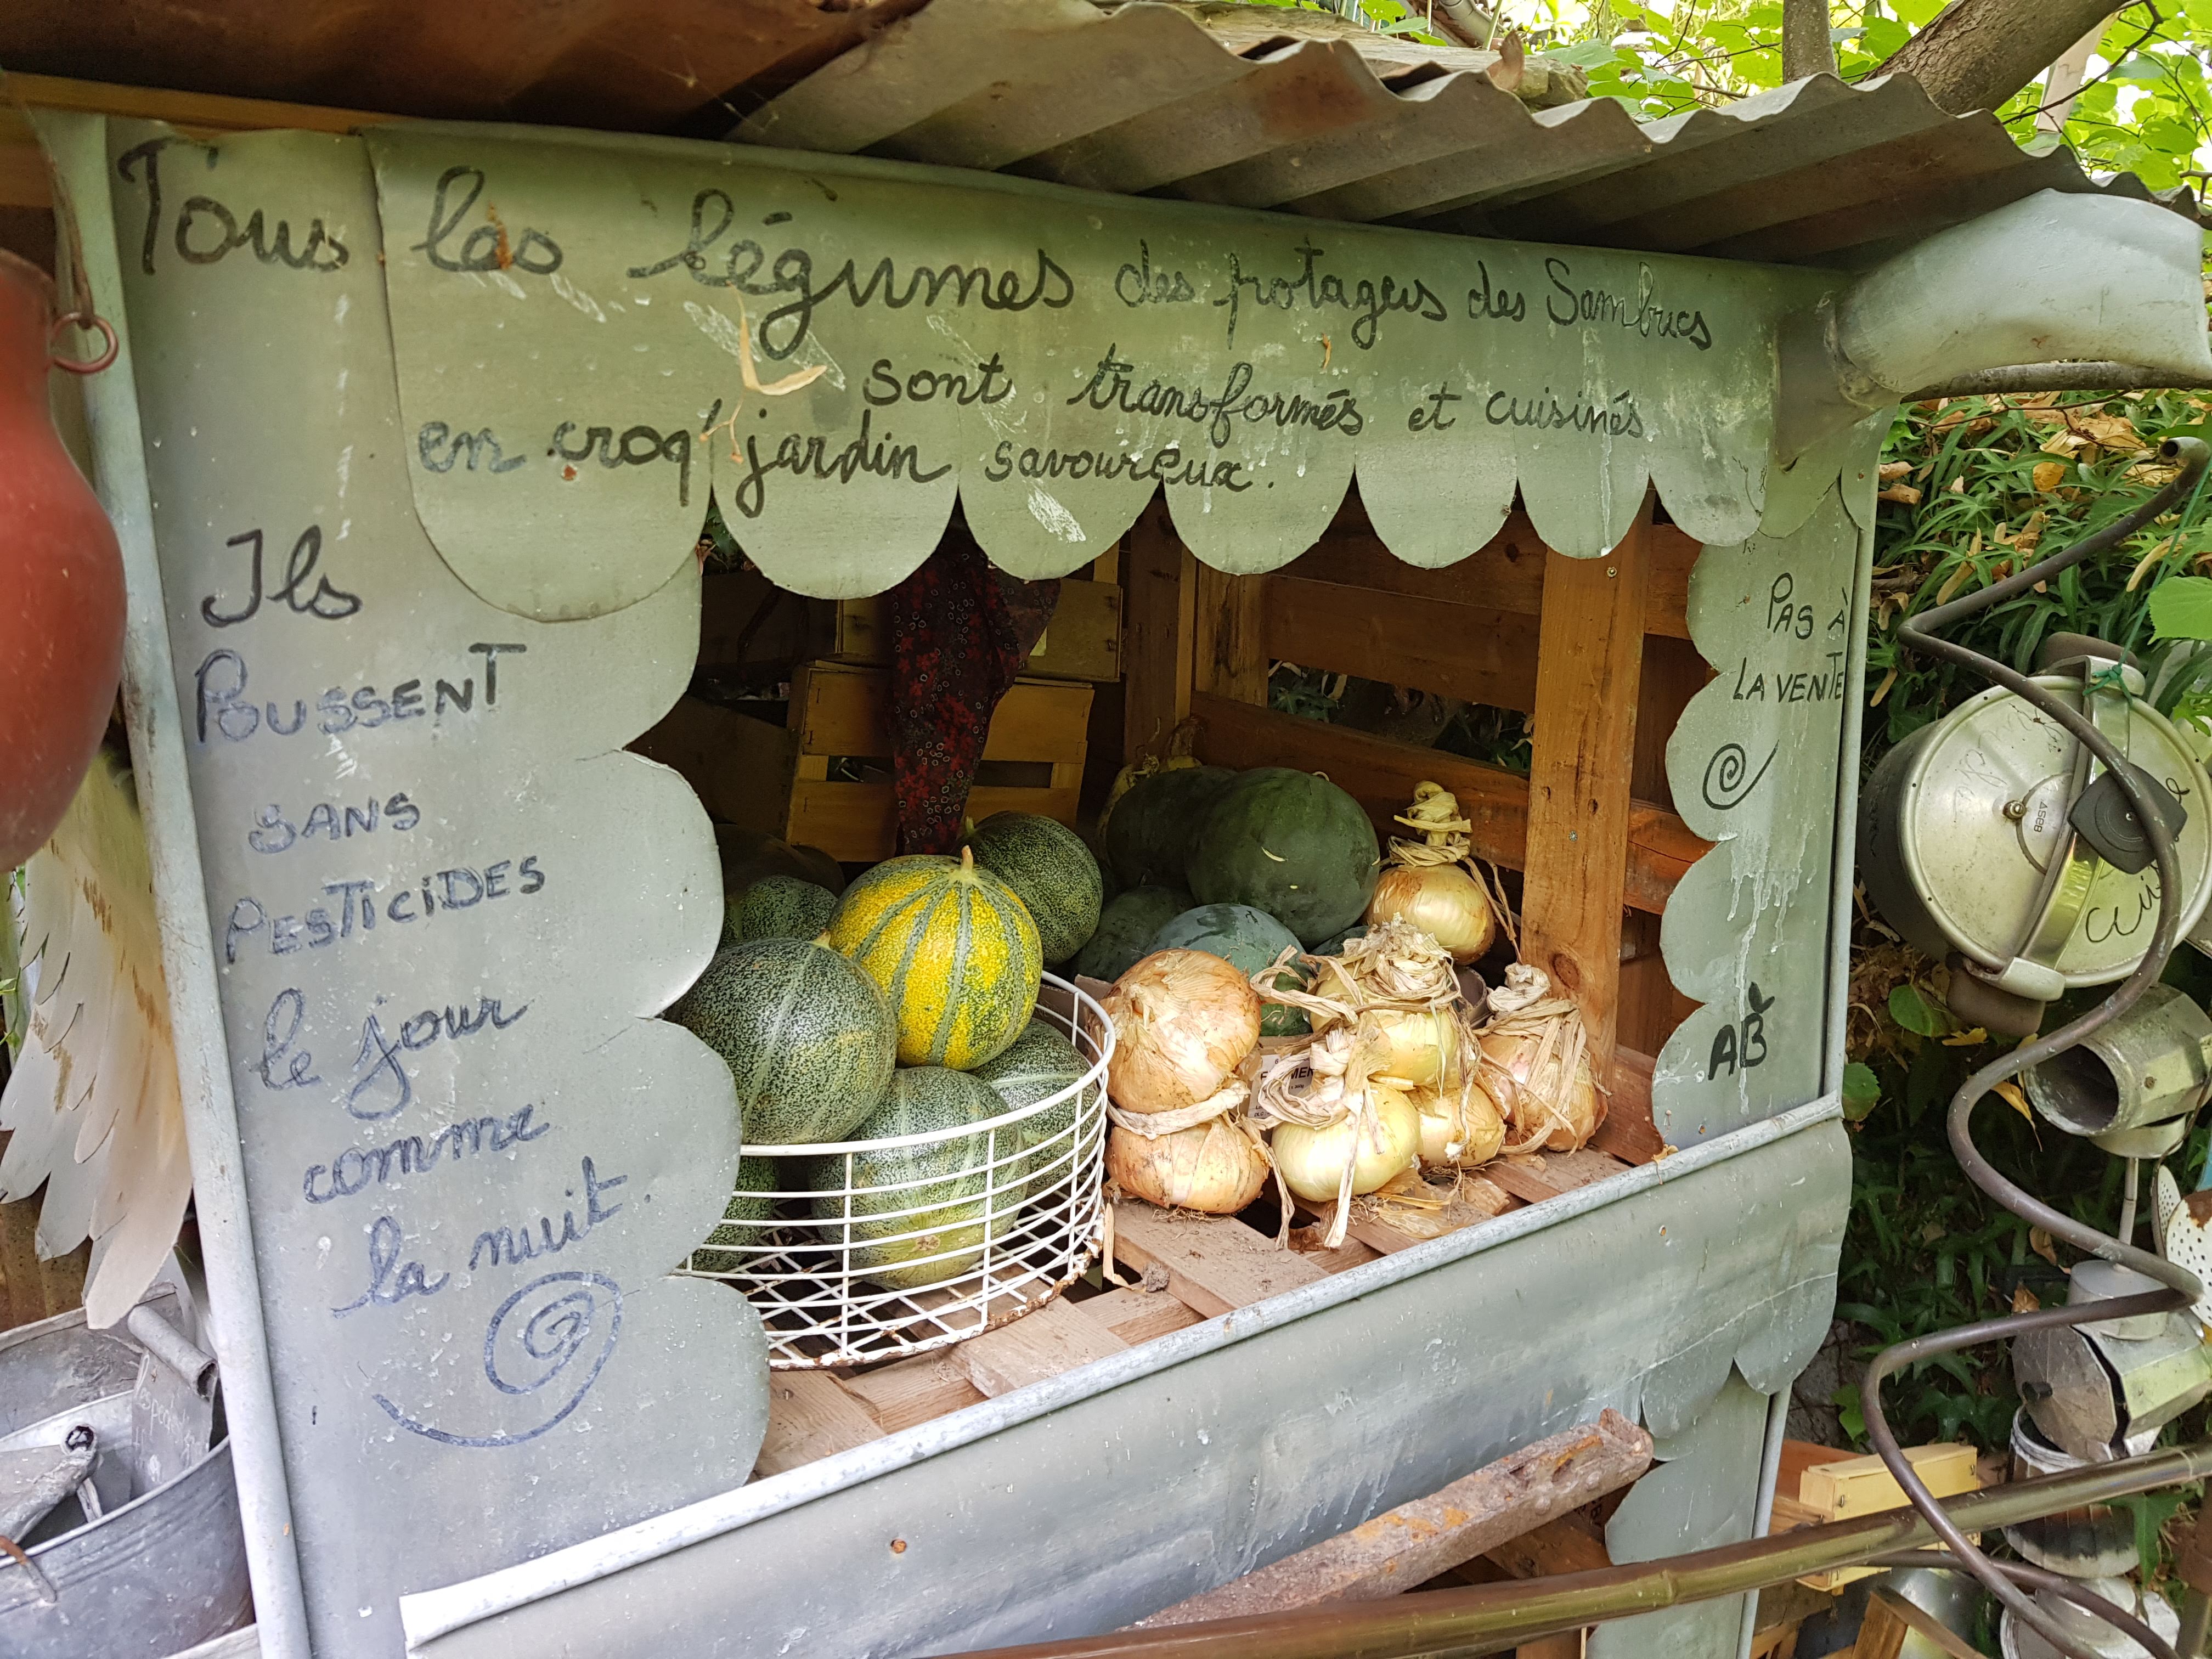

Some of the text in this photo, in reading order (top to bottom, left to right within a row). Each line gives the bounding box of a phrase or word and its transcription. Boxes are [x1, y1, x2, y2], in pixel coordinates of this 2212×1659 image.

[117, 136, 1713, 361] Tous les légumes des potagers des Sambucs
[864, 341, 1645, 447] sont transformés et cuisinés
[417, 420, 526, 474] en
[984, 439, 1276, 494] savoureux.
[1767, 573, 1848, 640] PAS À
[195, 642, 527, 744] POUSSENT
[1733, 651, 1844, 703] LA VENTE
[249, 792, 420, 854] SANS
[256, 988, 535, 1120] le jour
[303, 1103, 550, 1204] comme
[330, 1215, 450, 1319] la
